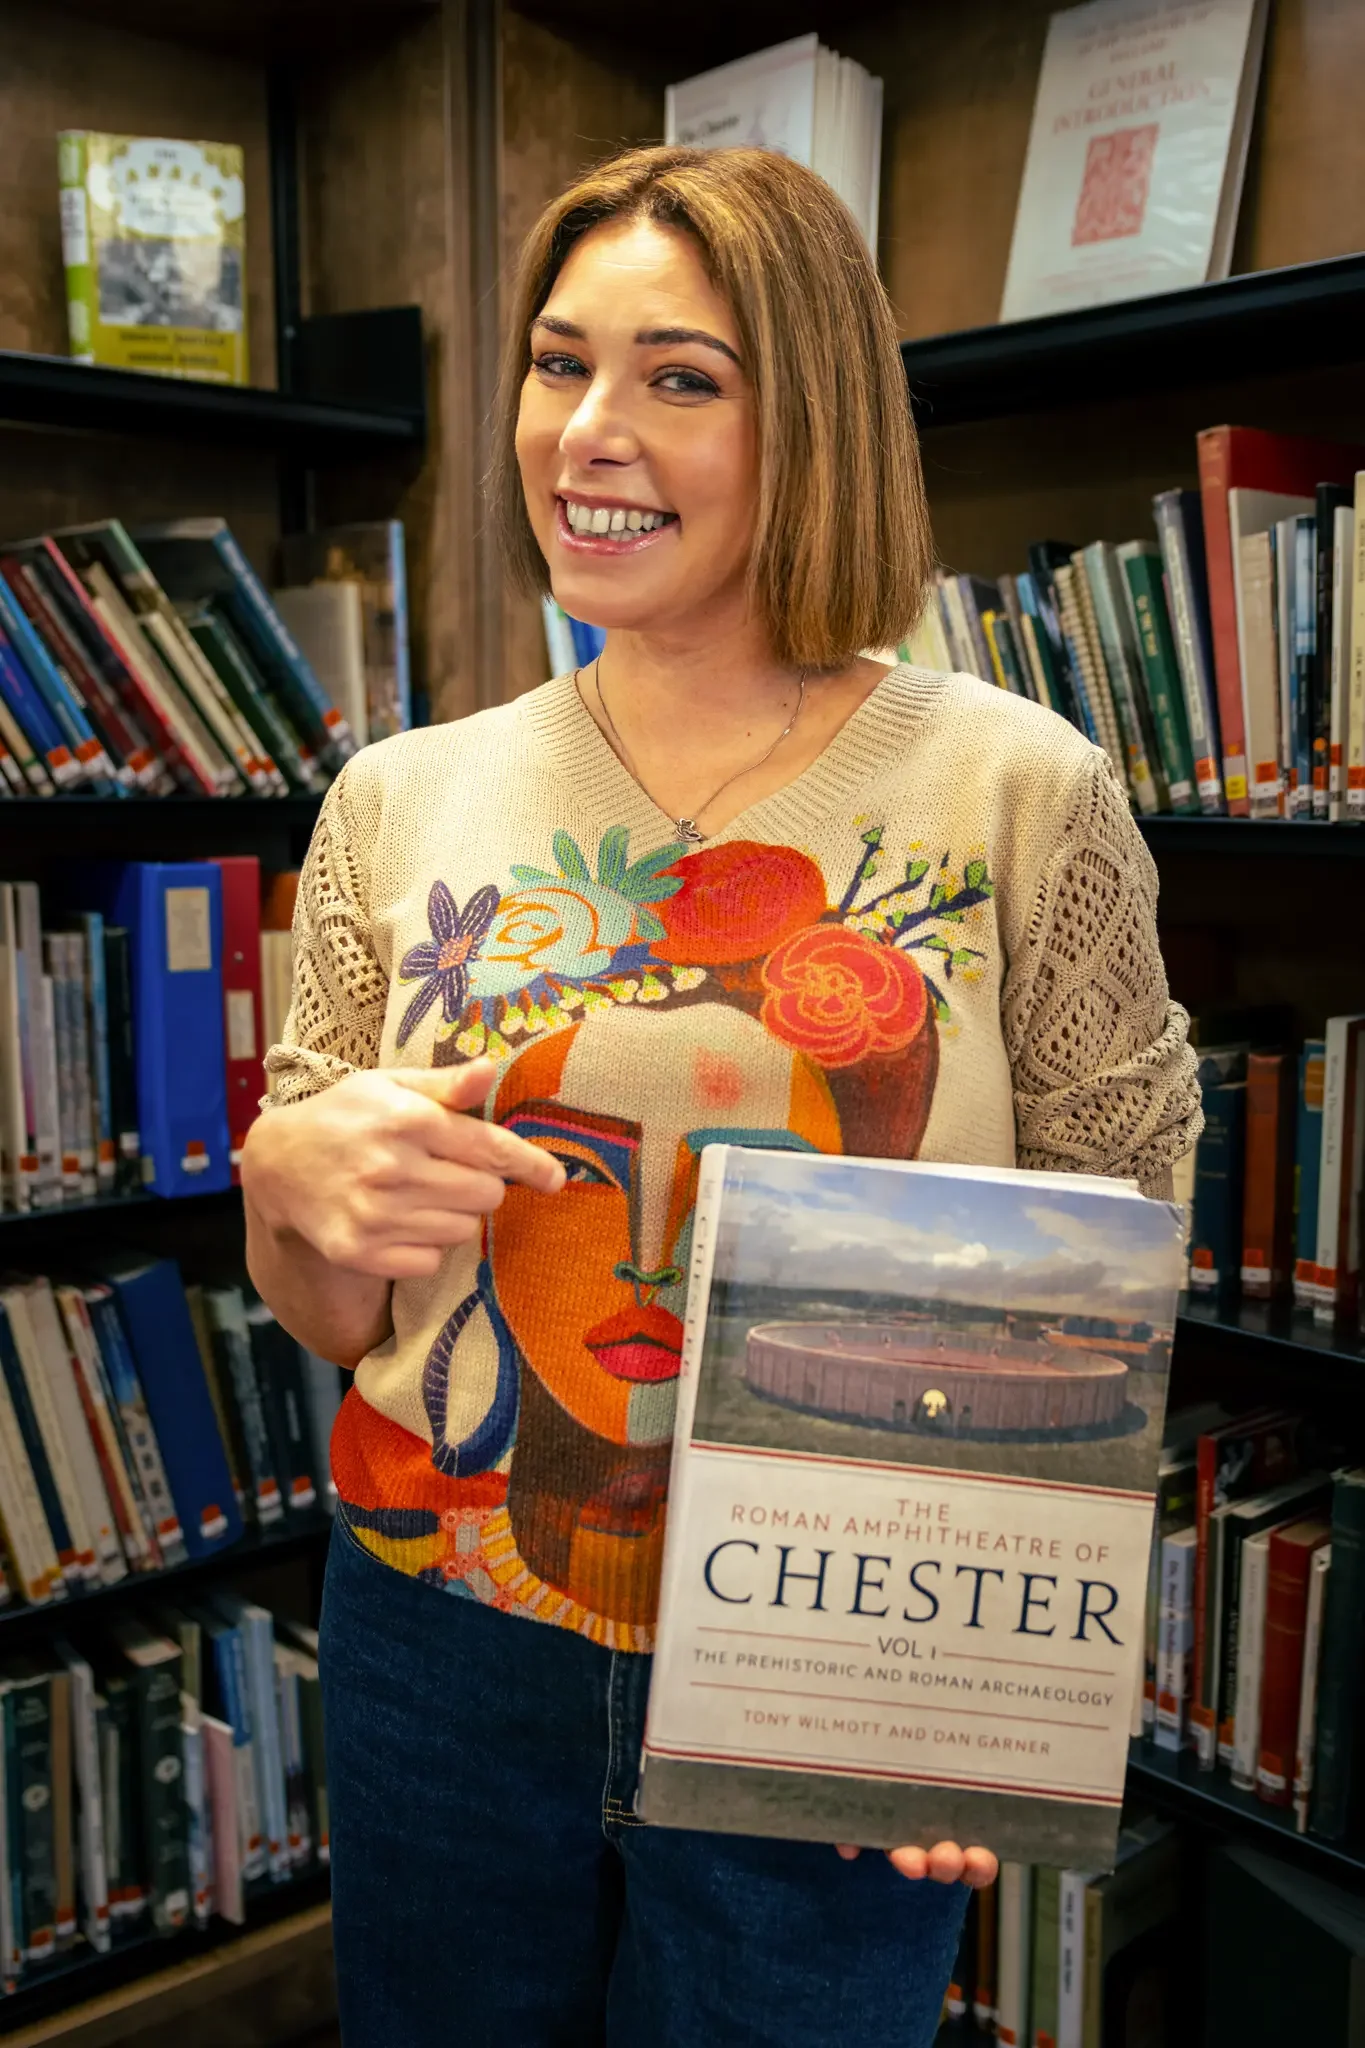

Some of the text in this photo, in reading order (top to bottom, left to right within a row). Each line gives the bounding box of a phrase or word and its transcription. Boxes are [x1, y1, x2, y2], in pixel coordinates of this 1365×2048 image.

[731, 1504, 1110, 1563] ROMAN AMPHITHEATRE OF
[896, 1498, 950, 1522] THE
[703, 1539, 1125, 1647] CHESTER
[877, 1635, 924, 1660] VOL
[694, 1648, 1115, 1708] THE PREHISTORIC AND ROMAN ARCHAEOLOGY
[744, 1709, 1051, 1756] TONY WILMOTT AND DAN GARNER
